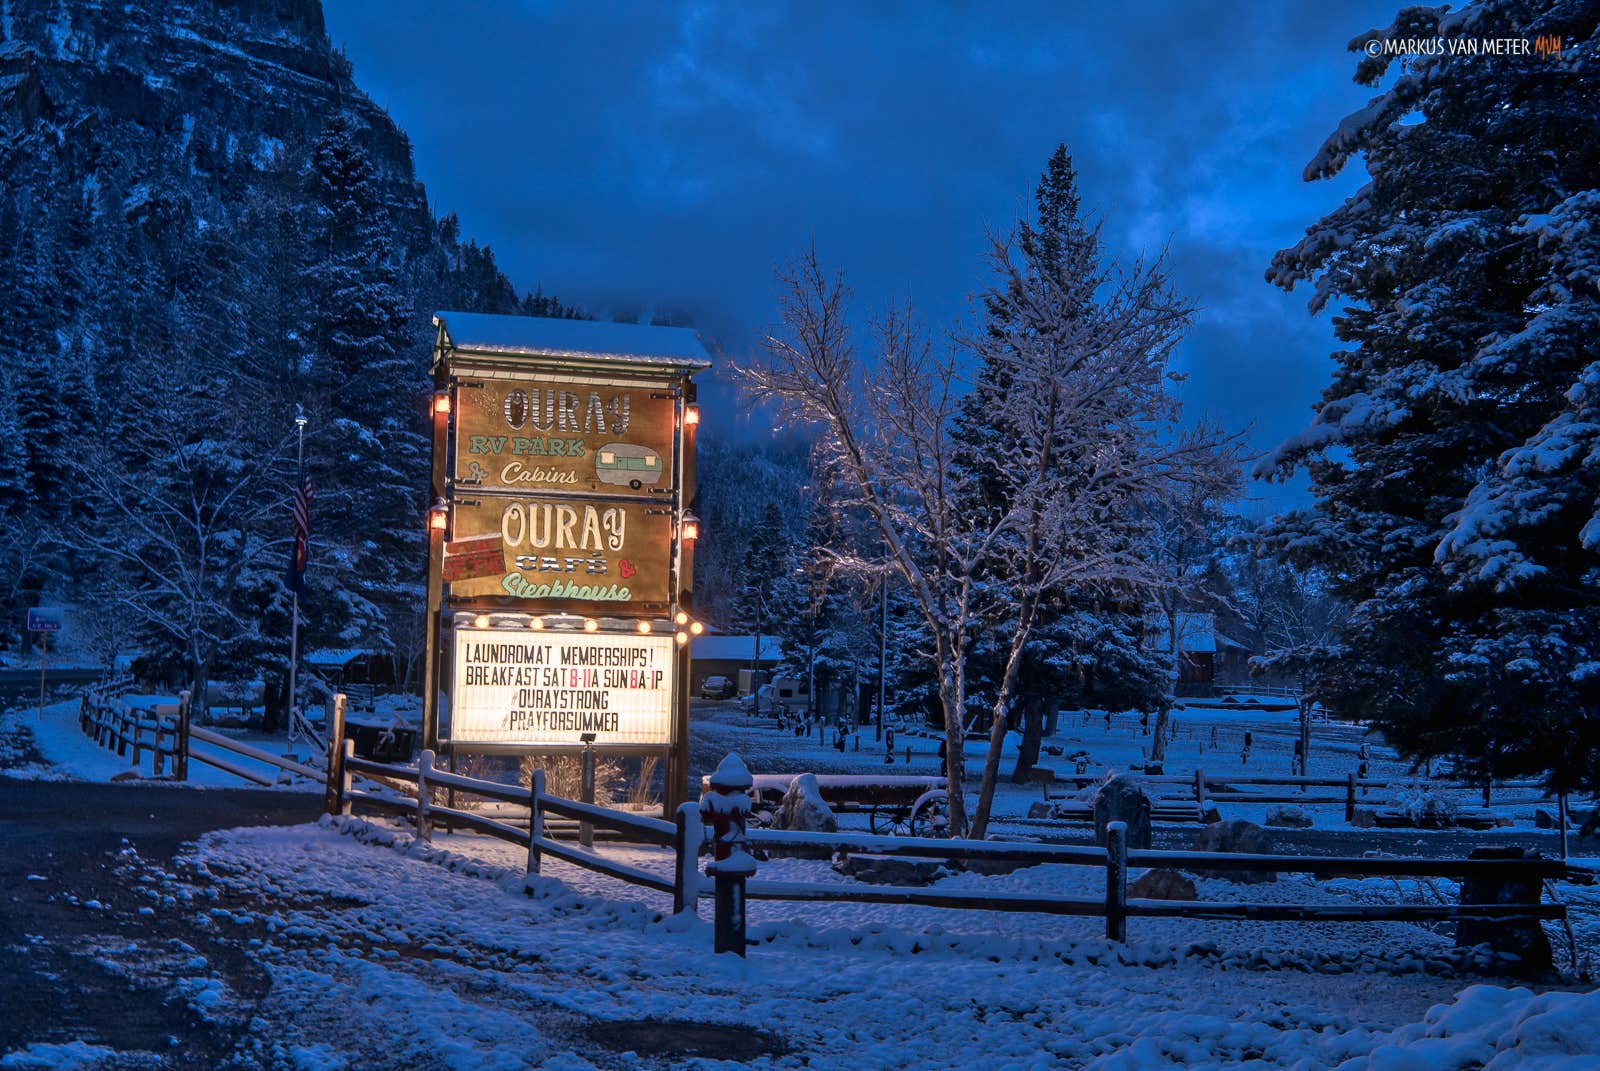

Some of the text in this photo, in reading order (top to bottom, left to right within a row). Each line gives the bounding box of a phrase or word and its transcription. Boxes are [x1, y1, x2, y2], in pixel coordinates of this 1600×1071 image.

[504, 387, 631, 436] OURAY
[470, 435, 586, 457] RV PARK
[500, 461, 578, 485] Cabins
[502, 502, 627, 551] OURAY
[502, 572, 632, 602] Steakhouse
[466, 643, 654, 668] LAUNDROMAT MEMBERSHIPS!
[466, 666, 539, 687] BREAKFAST
[543, 667, 567, 688] SAT
[604, 669, 628, 688] SUN
